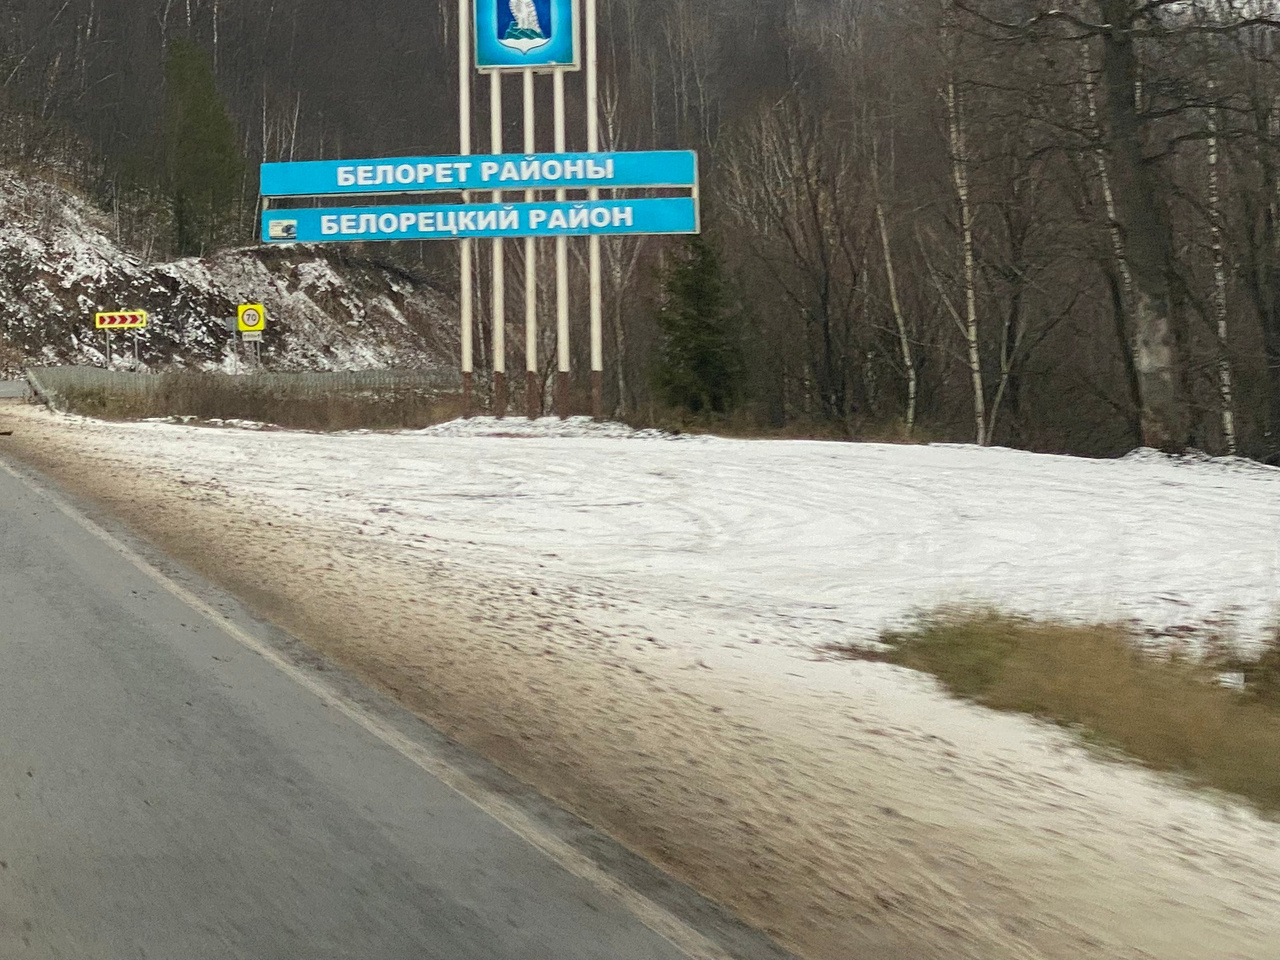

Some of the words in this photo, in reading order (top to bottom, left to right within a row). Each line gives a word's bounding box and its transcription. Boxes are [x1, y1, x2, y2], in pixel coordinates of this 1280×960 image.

[336, 163, 472, 187] БЕЛОРЕТ
[480, 156, 614, 182] РАЙОНЫ
[321, 206, 519, 236] БЕЛОРЕЦКИЙ
[529, 204, 634, 230] РАЙОН
[245, 313, 257, 322] 70
